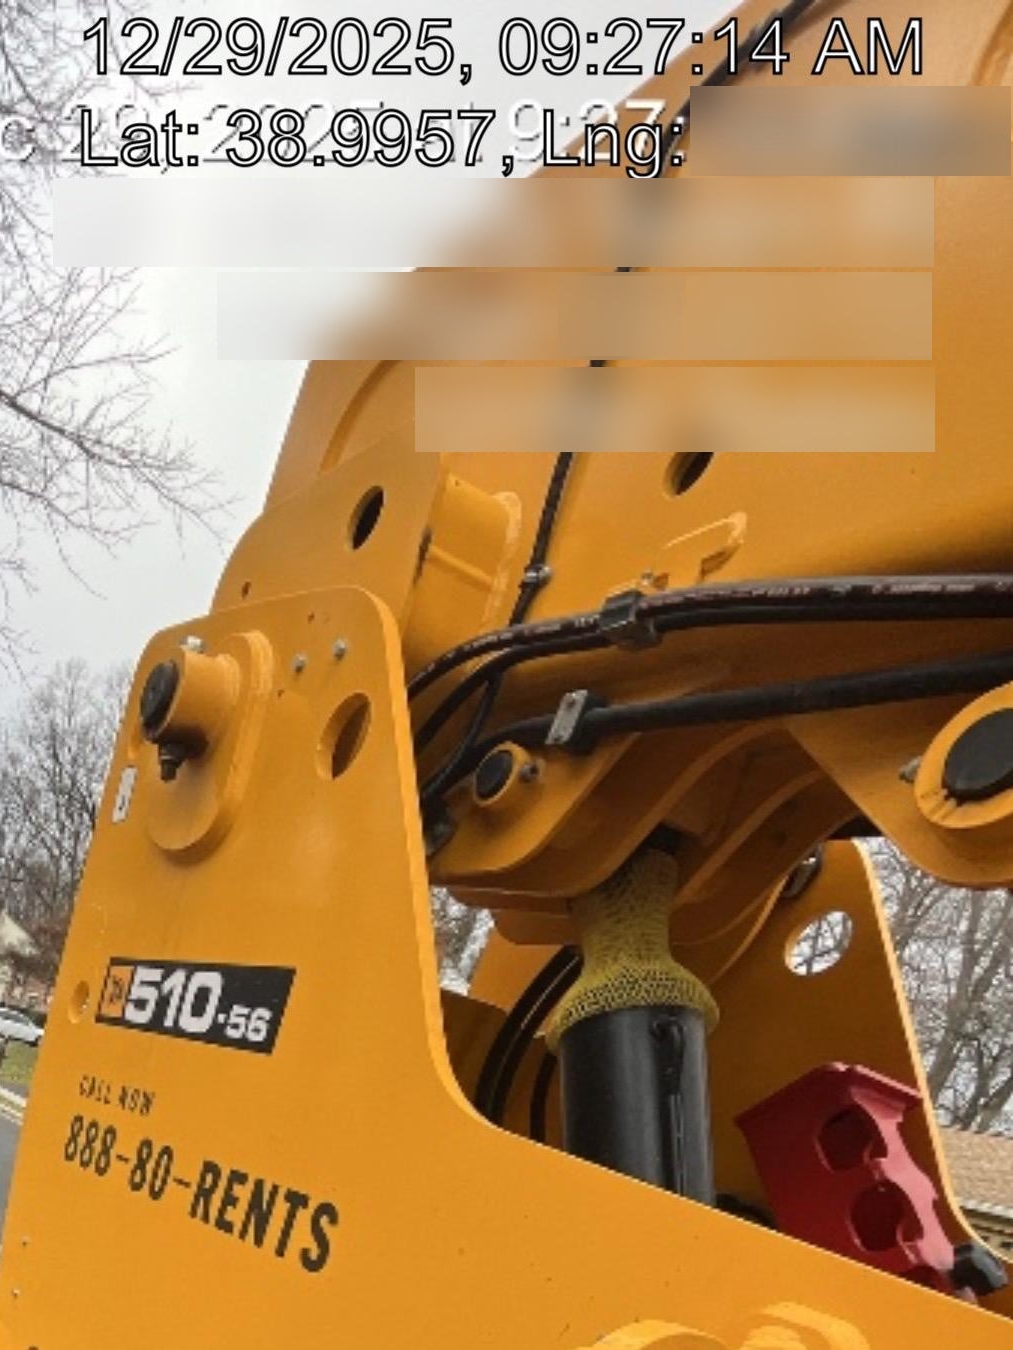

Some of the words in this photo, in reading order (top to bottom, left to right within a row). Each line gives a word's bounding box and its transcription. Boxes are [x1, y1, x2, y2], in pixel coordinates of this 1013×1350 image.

[78, 1074, 113, 1106] CALL
[118, 1084, 156, 1118] NOW
[63, 1114, 340, 1275] 888-80-RENTS
